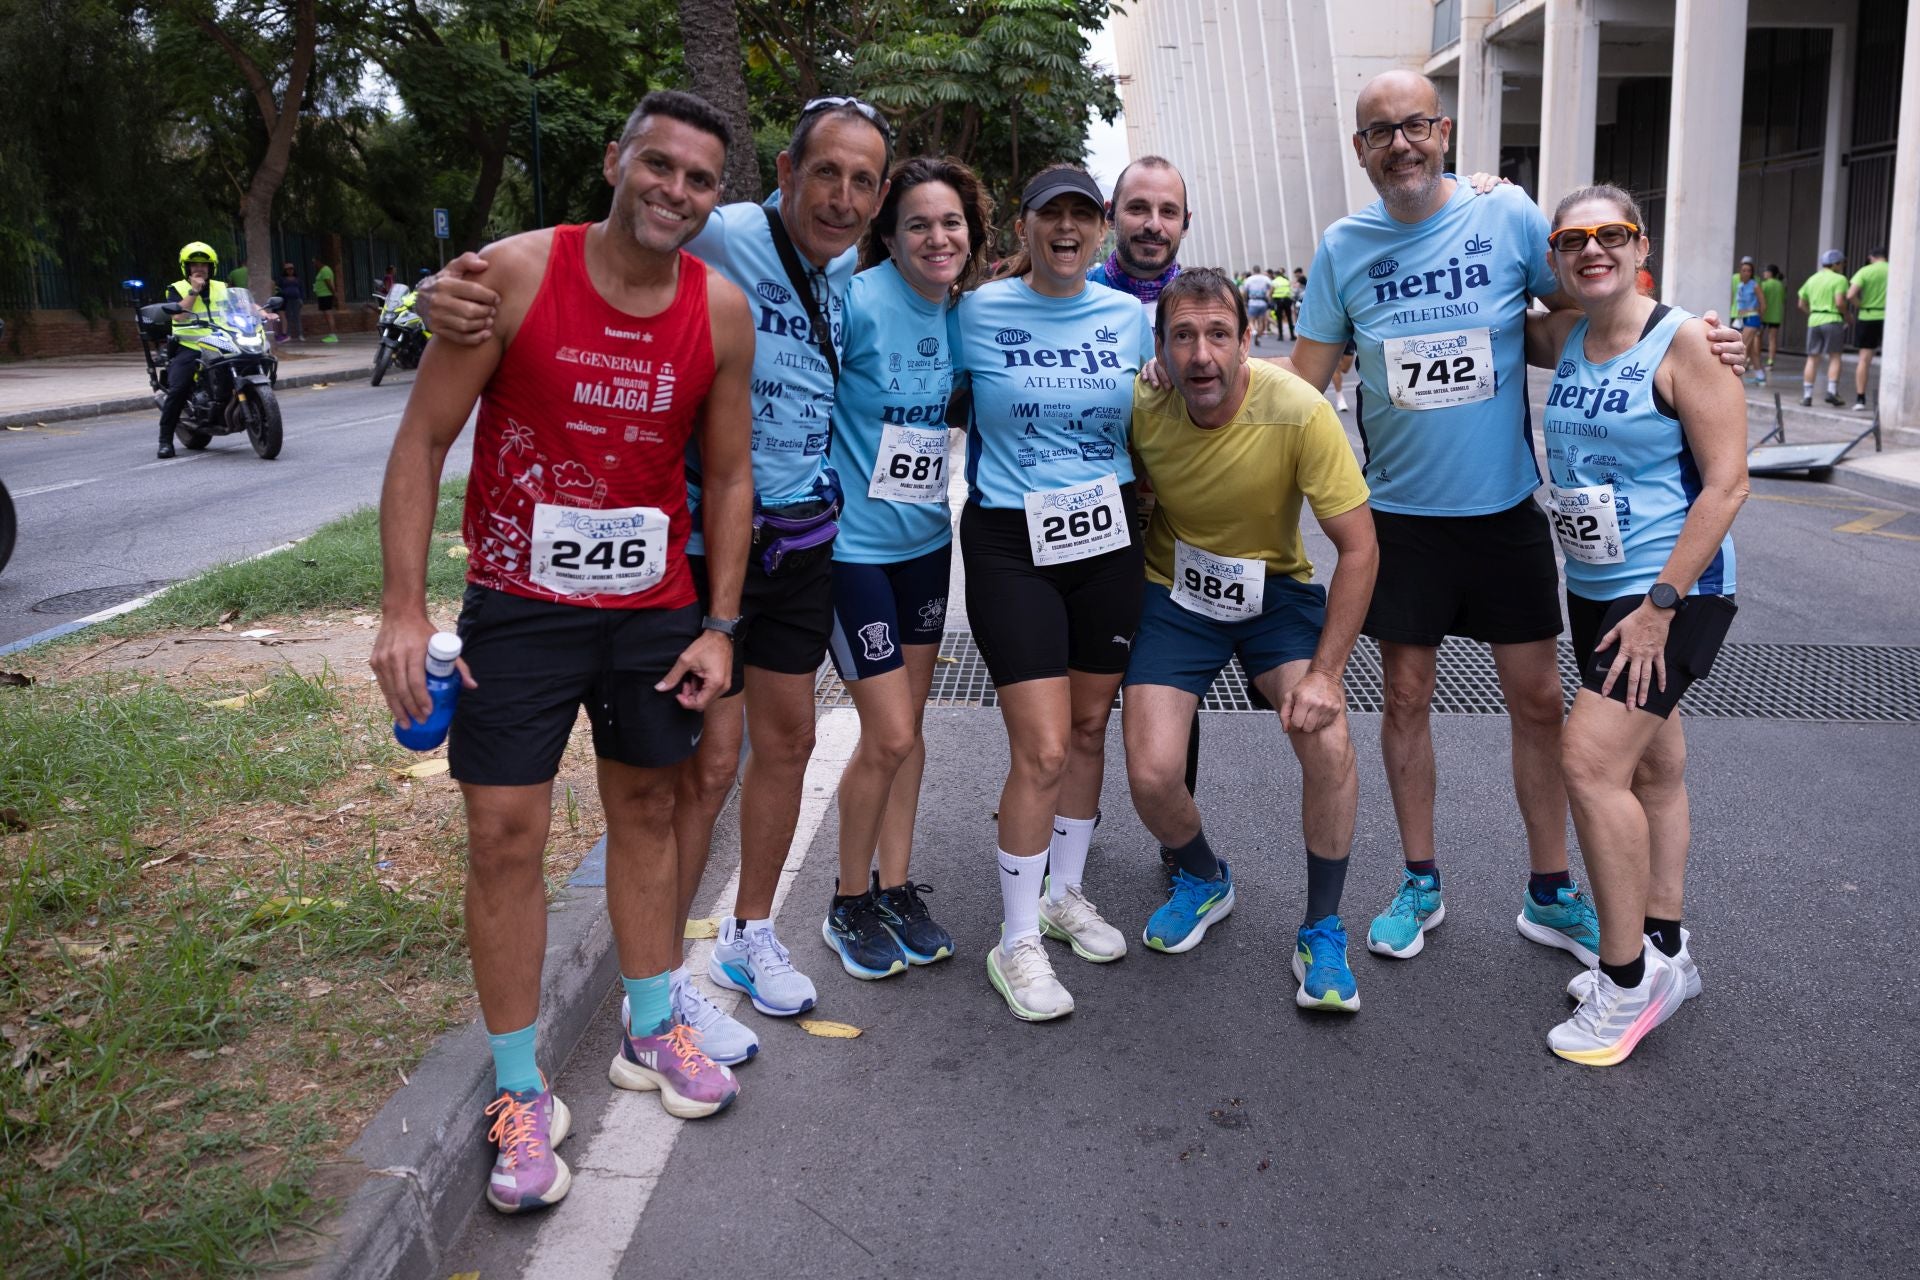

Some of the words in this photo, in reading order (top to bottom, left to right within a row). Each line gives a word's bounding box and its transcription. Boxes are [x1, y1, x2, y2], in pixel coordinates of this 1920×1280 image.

[1464, 233, 1492, 255] als
[1369, 260, 1399, 278] TROPS
[1374, 257, 1491, 305] nerja
[758, 284, 790, 302] TROPS
[1392, 301, 1479, 325] ATLETISMO
[604, 326, 641, 340] luanvi
[996, 330, 1031, 344] TROPS
[1096, 325, 1118, 343] als
[918, 338, 940, 354] TROPS
[580, 350, 653, 374] GENERALI
[1002, 342, 1121, 374] nerja
[1401, 356, 1477, 389] 742
[1618, 362, 1647, 381] als
[1024, 376, 1117, 391] ATLETISMO
[573, 381, 649, 412] MÁLAGA
[1547, 378, 1630, 419] nerja
[880, 396, 947, 427] nerj
[1043, 410, 1073, 419] Málaga
[1096, 406, 1121, 414] CUEVA
[566, 420, 607, 435] málaga
[1547, 420, 1608, 439] ATLETISMO
[1051, 446, 1078, 457] activa
[1593, 454, 1617, 462] CUEVA
[889, 453, 944, 481] 681
[1043, 504, 1113, 543] 260
[1551, 510, 1602, 542] 252
[551, 538, 647, 570] 246
[1184, 567, 1246, 606] 984
